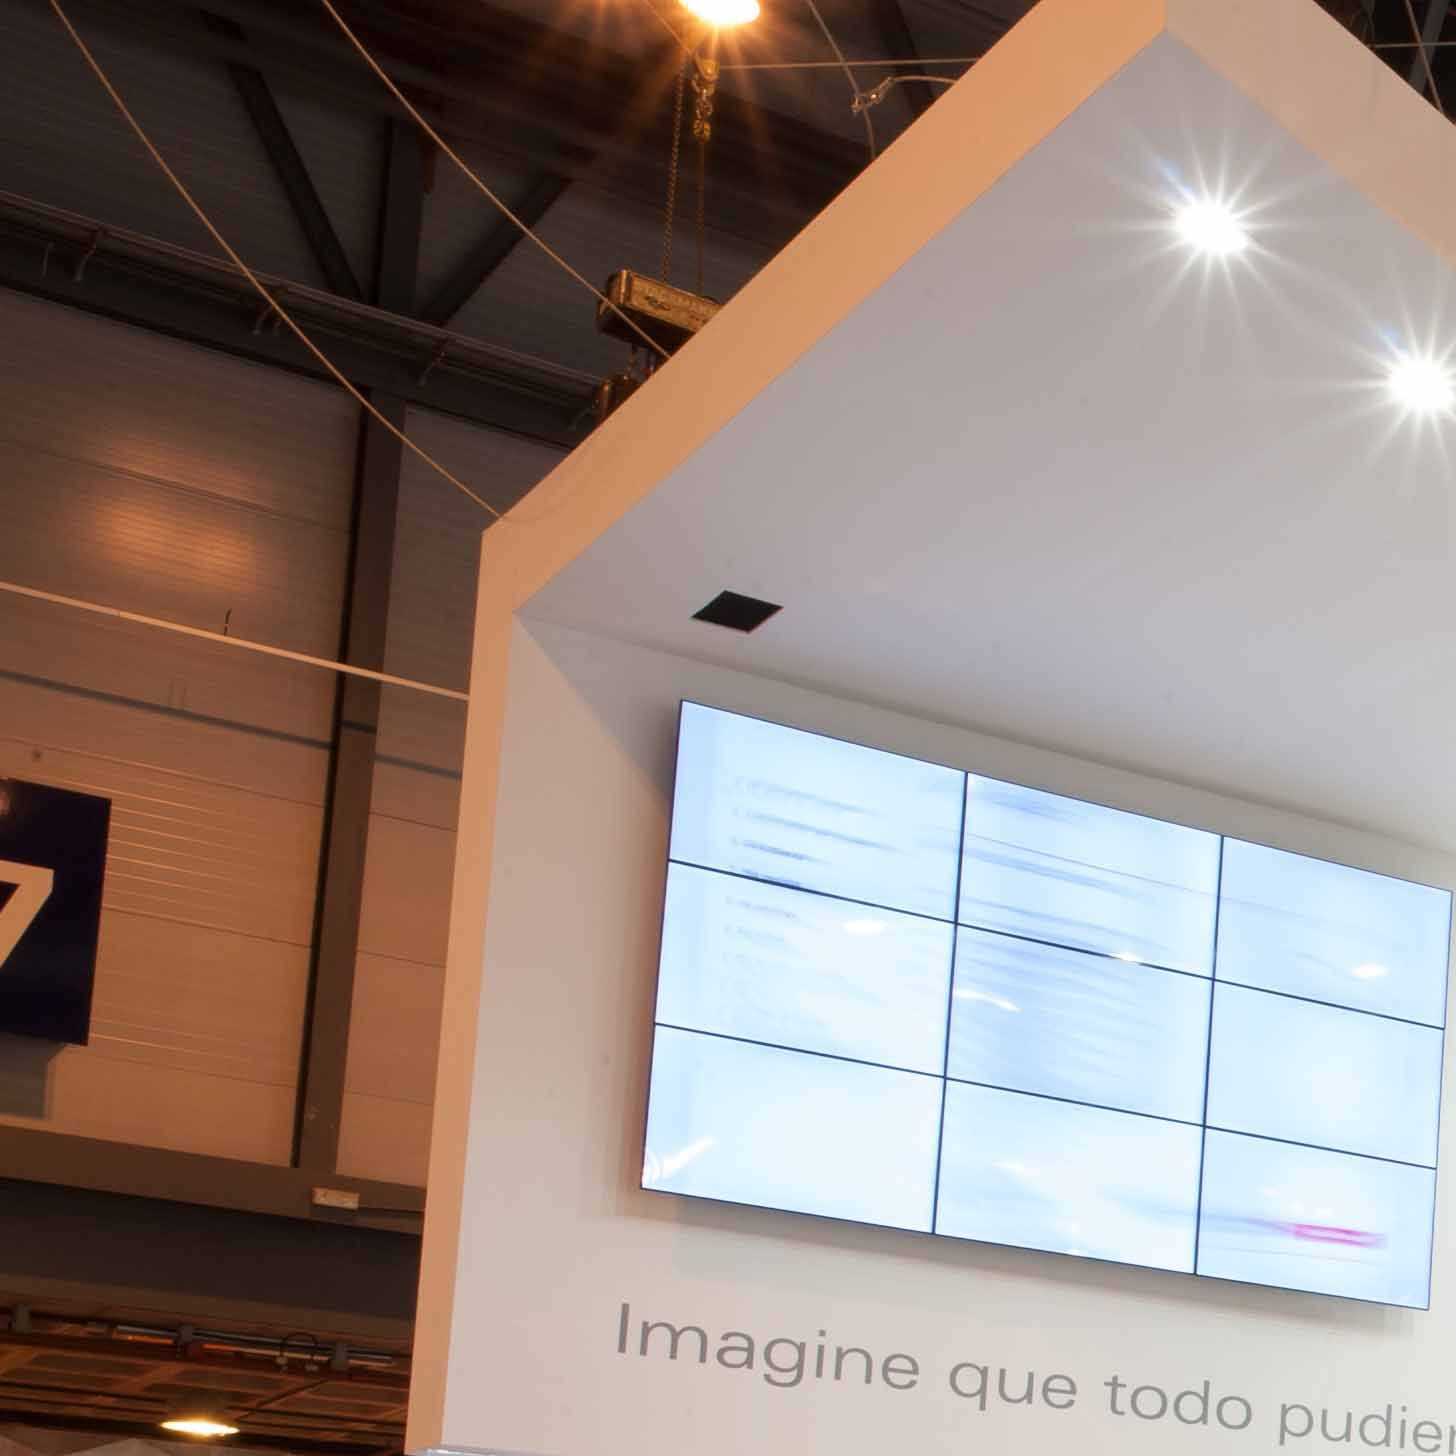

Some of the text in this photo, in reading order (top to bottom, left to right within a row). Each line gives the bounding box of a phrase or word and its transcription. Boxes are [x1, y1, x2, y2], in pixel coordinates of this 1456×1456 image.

[617, 1303, 920, 1388] Imagine
[948, 1362, 1077, 1412] que
[1103, 1374, 1253, 1430] todo
